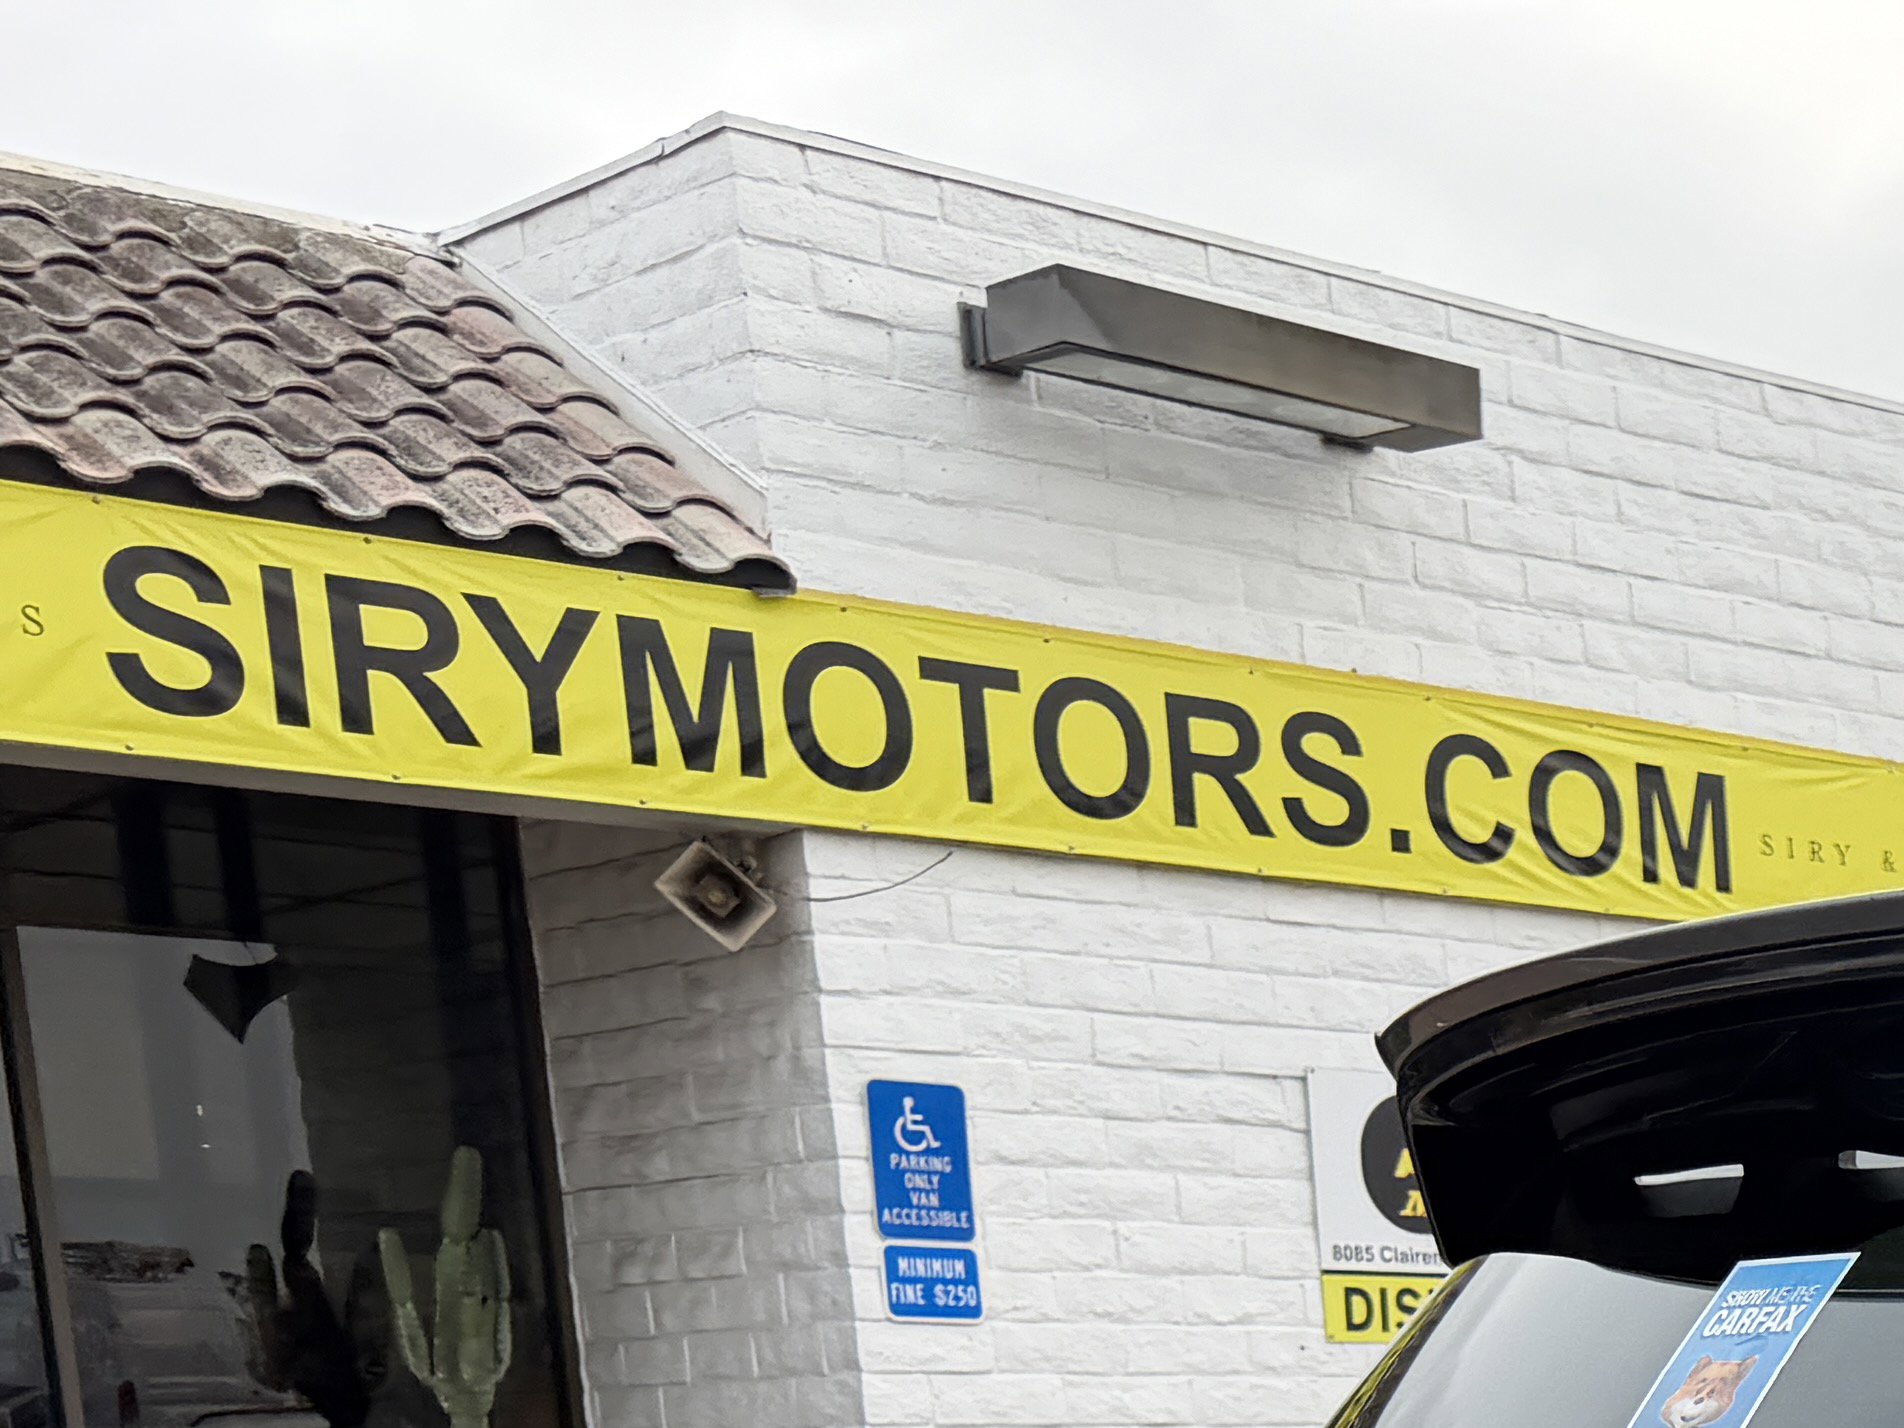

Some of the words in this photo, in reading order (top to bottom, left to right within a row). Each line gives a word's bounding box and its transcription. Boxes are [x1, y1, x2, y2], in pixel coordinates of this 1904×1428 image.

[103, 545, 1732, 893] SIRYMOTORS.COM
[1759, 833, 1851, 867] SIRY
[1881, 850, 1898, 873] &
[889, 1153, 953, 1174] PARKING
[904, 1172, 941, 1190] ONLY
[909, 1191, 940, 1208] VAN
[882, 1207, 970, 1229] ACCESSIBLE
[898, 1256, 966, 1280] MINIMUM
[890, 1282, 925, 1305] FINE
[933, 1283, 978, 1308] $250
[1702, 1305, 1808, 1337] CARFAX
